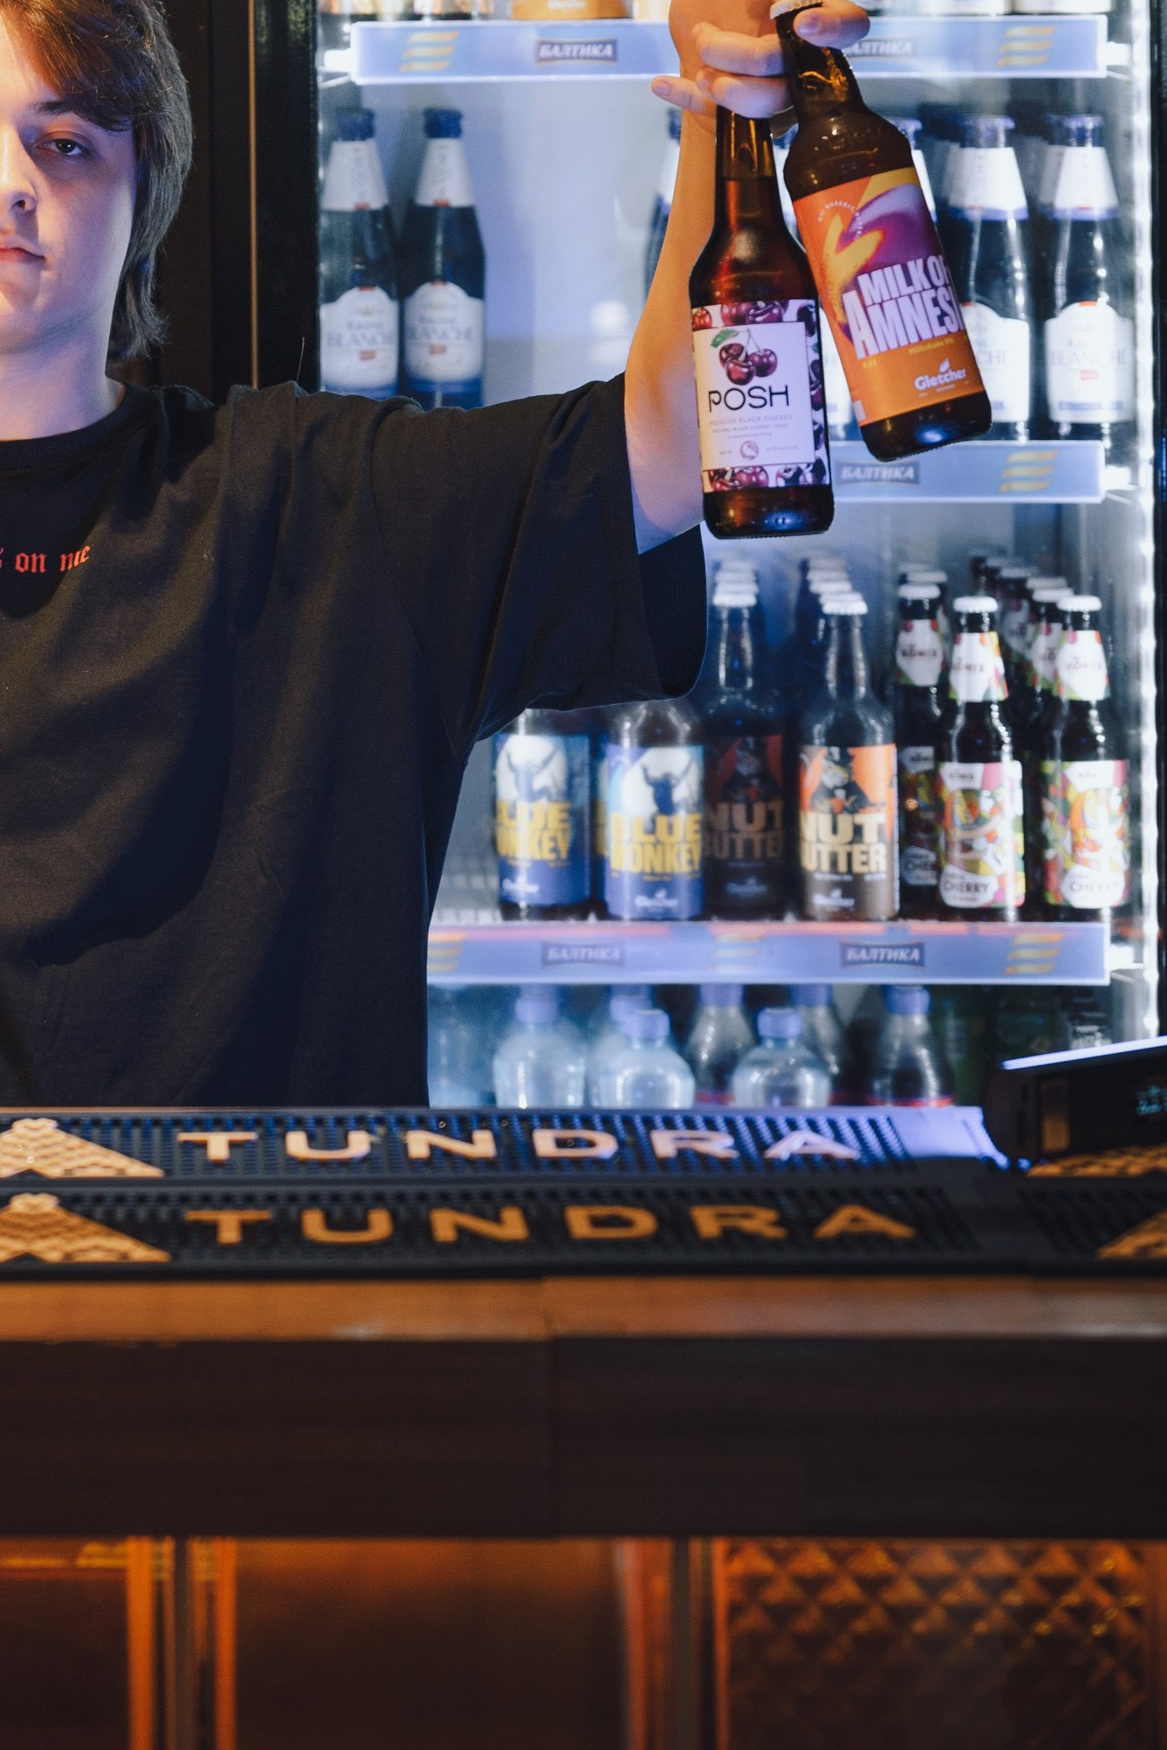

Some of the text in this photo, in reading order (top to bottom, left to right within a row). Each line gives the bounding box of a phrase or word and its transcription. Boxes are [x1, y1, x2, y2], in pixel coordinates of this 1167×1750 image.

[538, 43, 614, 59] БАЛТИКА
[846, 40, 913, 57] АЛТИКА
[857, 258, 932, 307] MILK
[914, 368, 967, 391] Gletcher
[708, 384, 790, 413] POSH
[841, 466, 915, 479] БАЛТИКА
[15, 552, 47, 574] on
[496, 800, 571, 830] LUE
[610, 812, 702, 843] BLUE
[800, 843, 888, 874] UTTER
[943, 879, 990, 893] CHERRY
[547, 947, 621, 961] БАЛТИКА
[846, 947, 921, 961] БАЛТИКА
[179, 1128, 864, 1160] TUNDRA
[186, 1204, 917, 1242] TUNDRA
